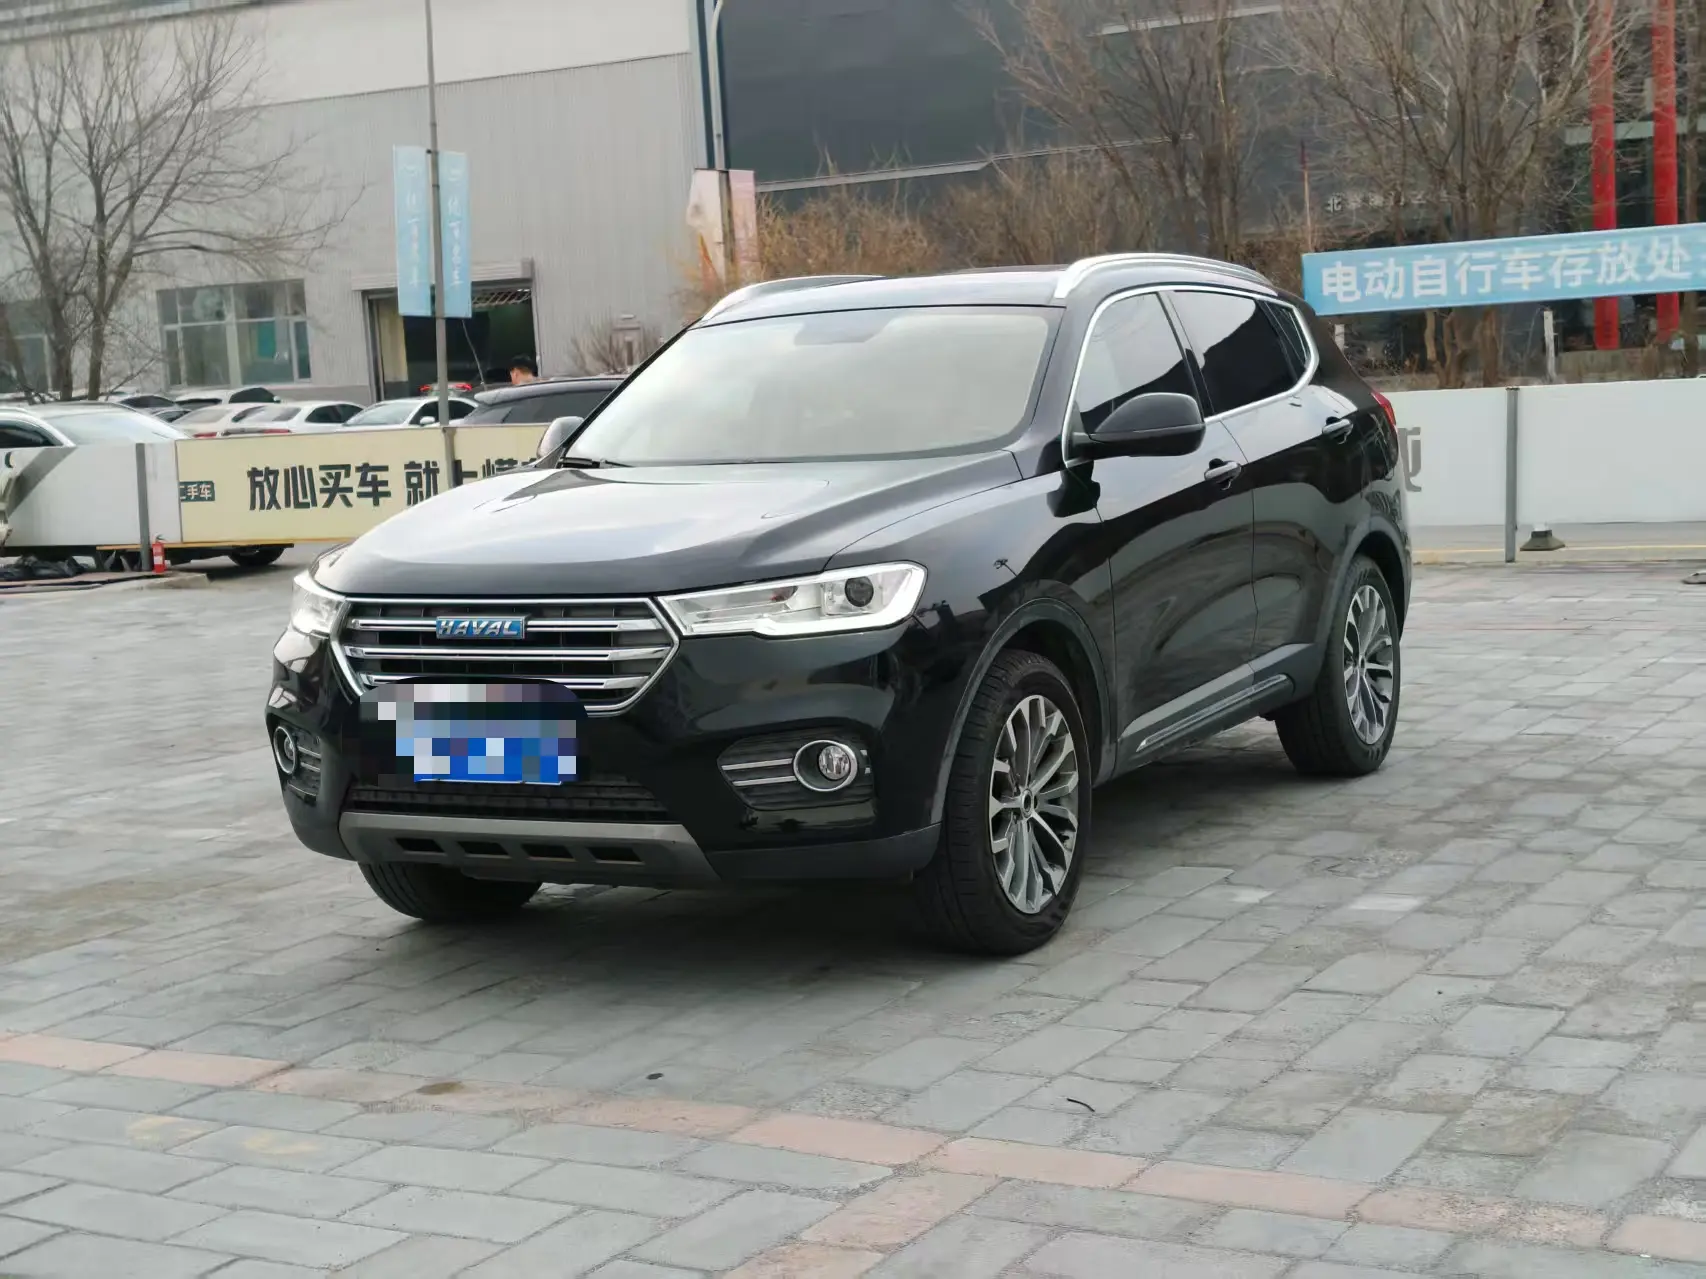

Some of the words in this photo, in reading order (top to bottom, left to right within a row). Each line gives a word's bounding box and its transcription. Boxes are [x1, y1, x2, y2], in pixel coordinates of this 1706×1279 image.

[1321, 236, 1692, 302] 电动自行车存放处
[440, 620, 517, 634] HAVAL
